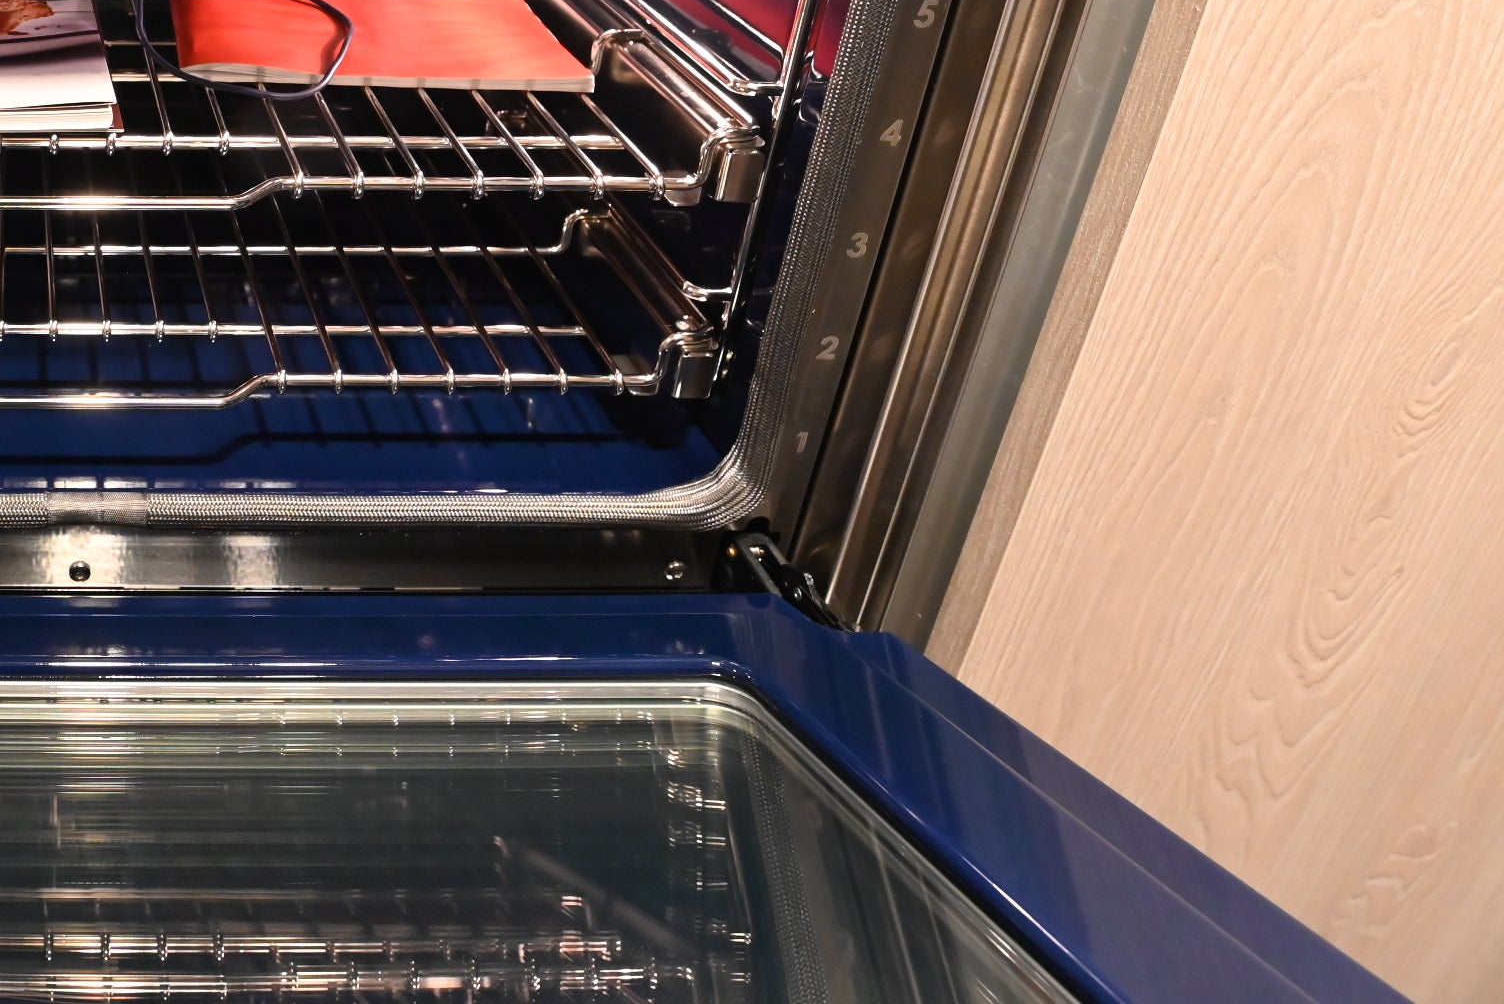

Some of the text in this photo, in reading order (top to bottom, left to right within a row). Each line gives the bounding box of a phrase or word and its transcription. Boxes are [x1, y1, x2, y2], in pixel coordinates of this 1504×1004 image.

[879, 119, 904, 147] 4
[846, 232, 869, 259] 3
[815, 335, 840, 361] 2
